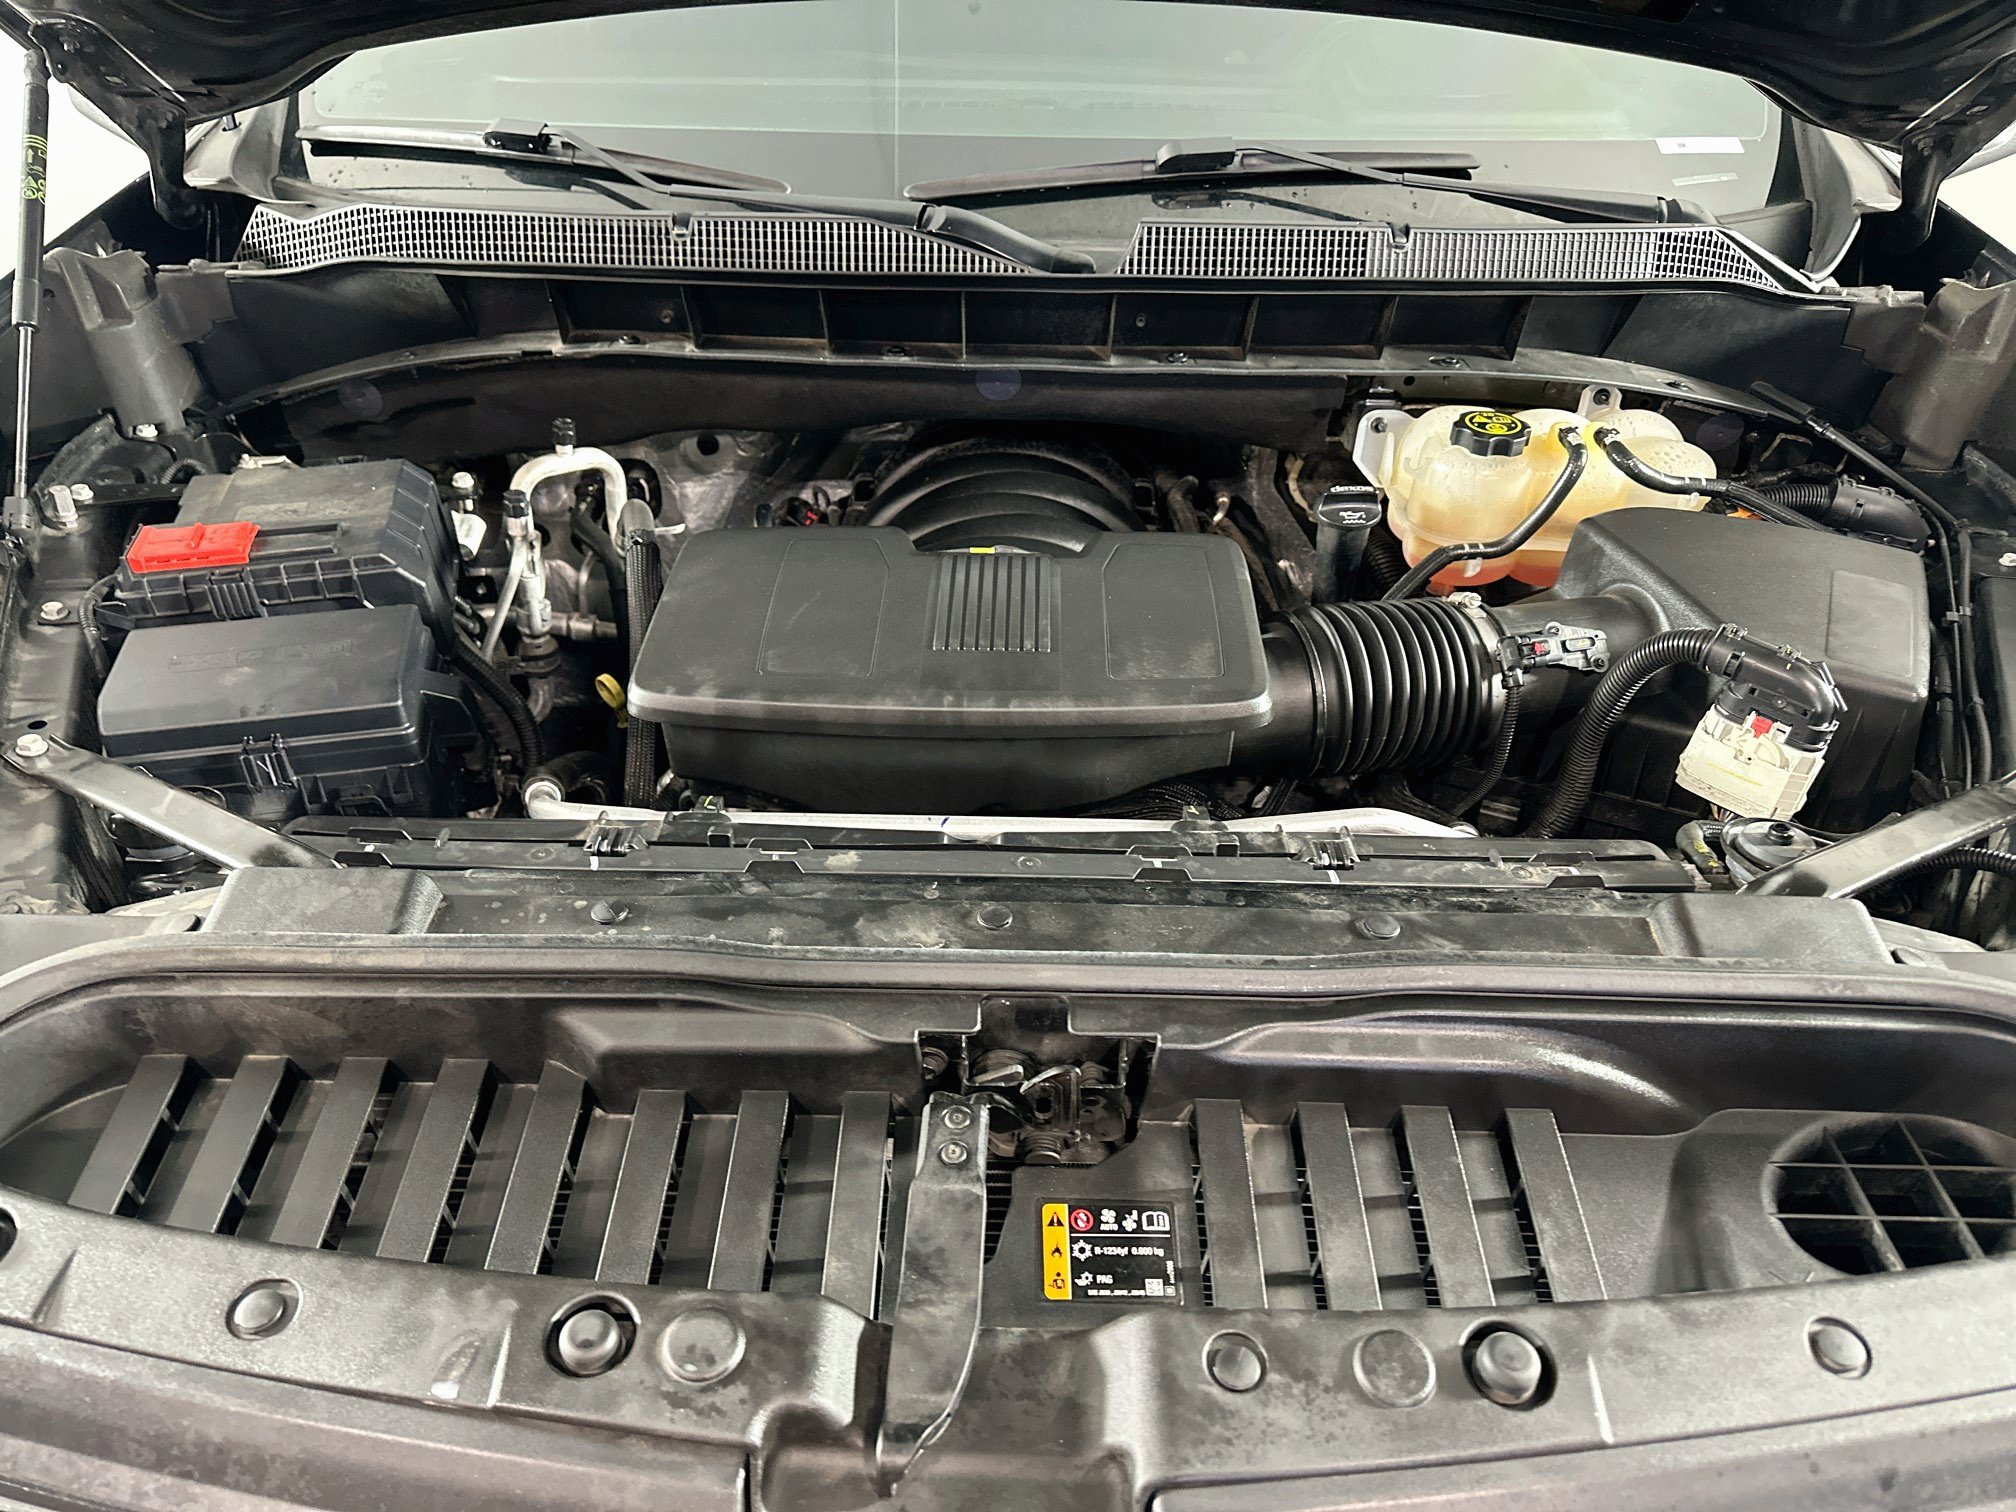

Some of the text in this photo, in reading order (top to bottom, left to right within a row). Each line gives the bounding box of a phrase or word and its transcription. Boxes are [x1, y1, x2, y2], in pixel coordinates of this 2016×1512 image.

[1100, 1223, 1118, 1231] AUTO
[1094, 1246, 1128, 1257] R-1234yf
[1154, 1246, 1165, 1257] kg
[1096, 1275, 1113, 1284] PAG
